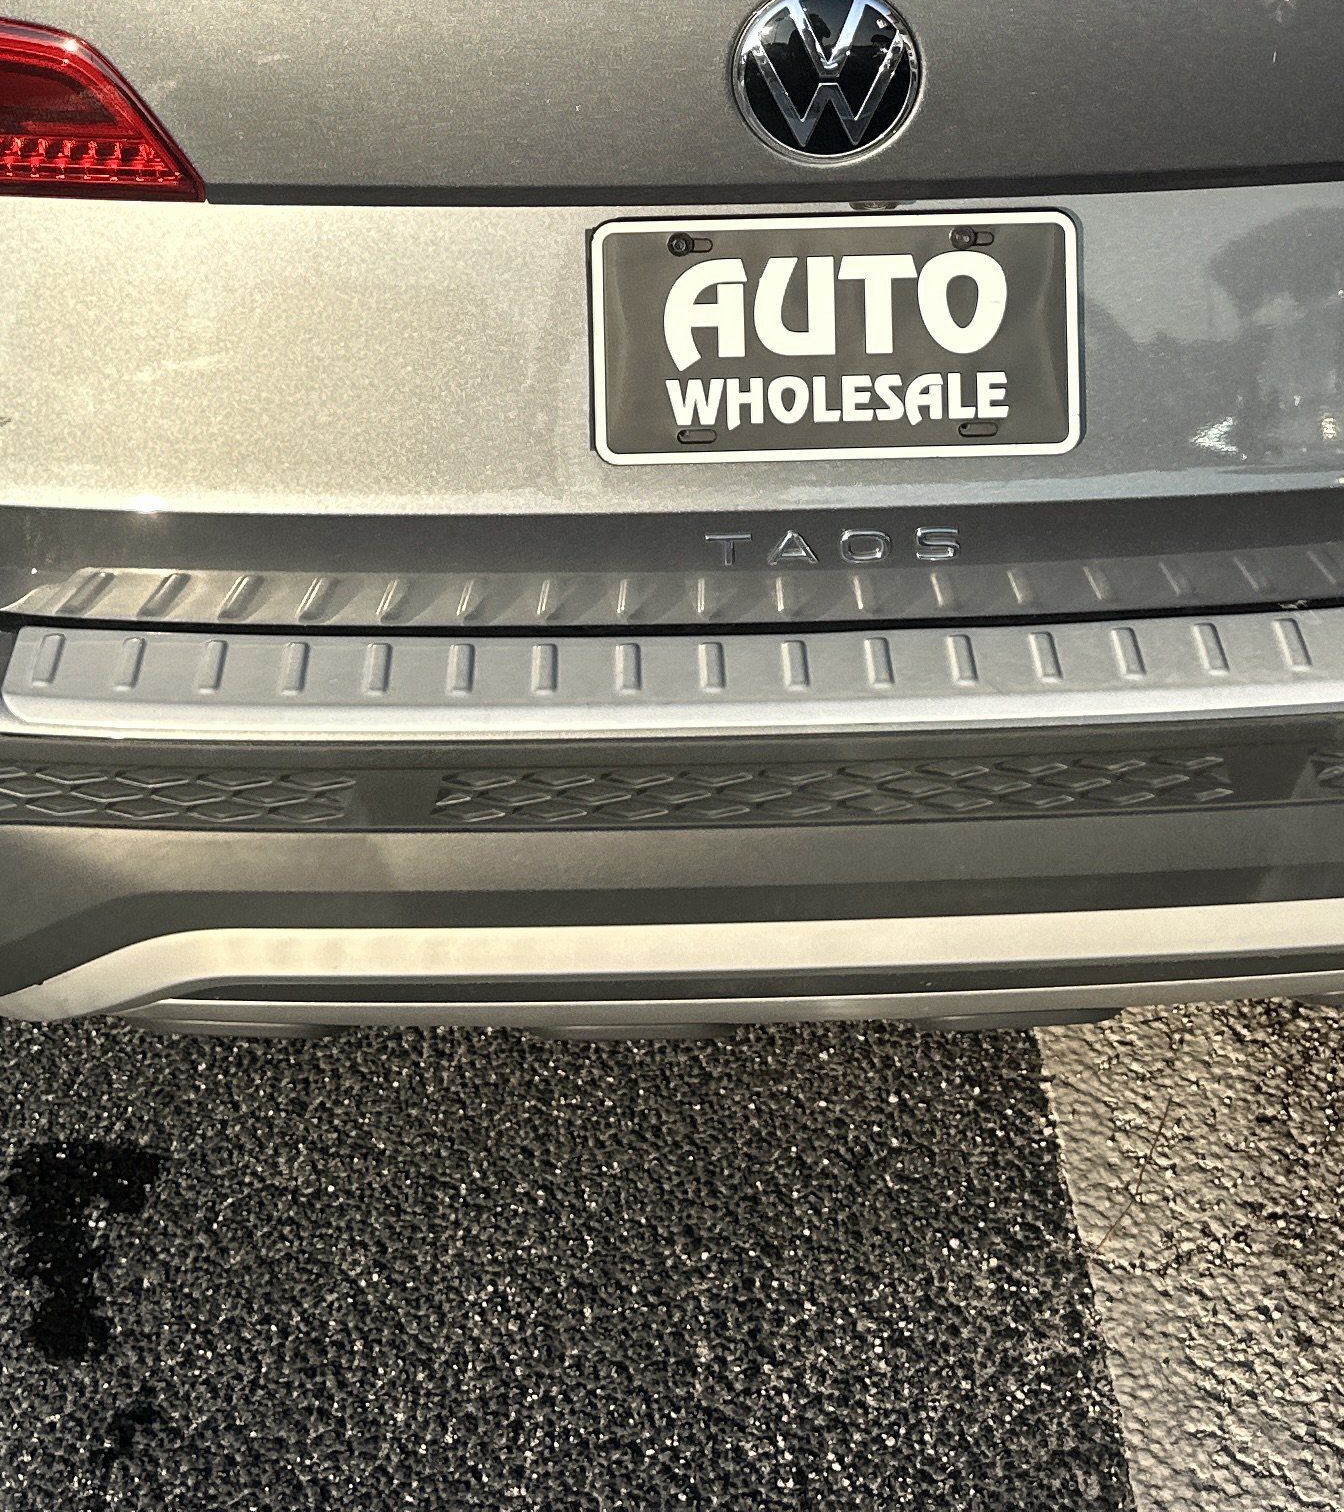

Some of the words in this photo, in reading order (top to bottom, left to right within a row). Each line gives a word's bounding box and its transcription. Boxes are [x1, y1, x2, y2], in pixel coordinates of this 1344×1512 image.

[663, 250, 1008, 372] AUTO
[665, 371, 1009, 431] WHOLESALE
[704, 525, 960, 567] TAOS
